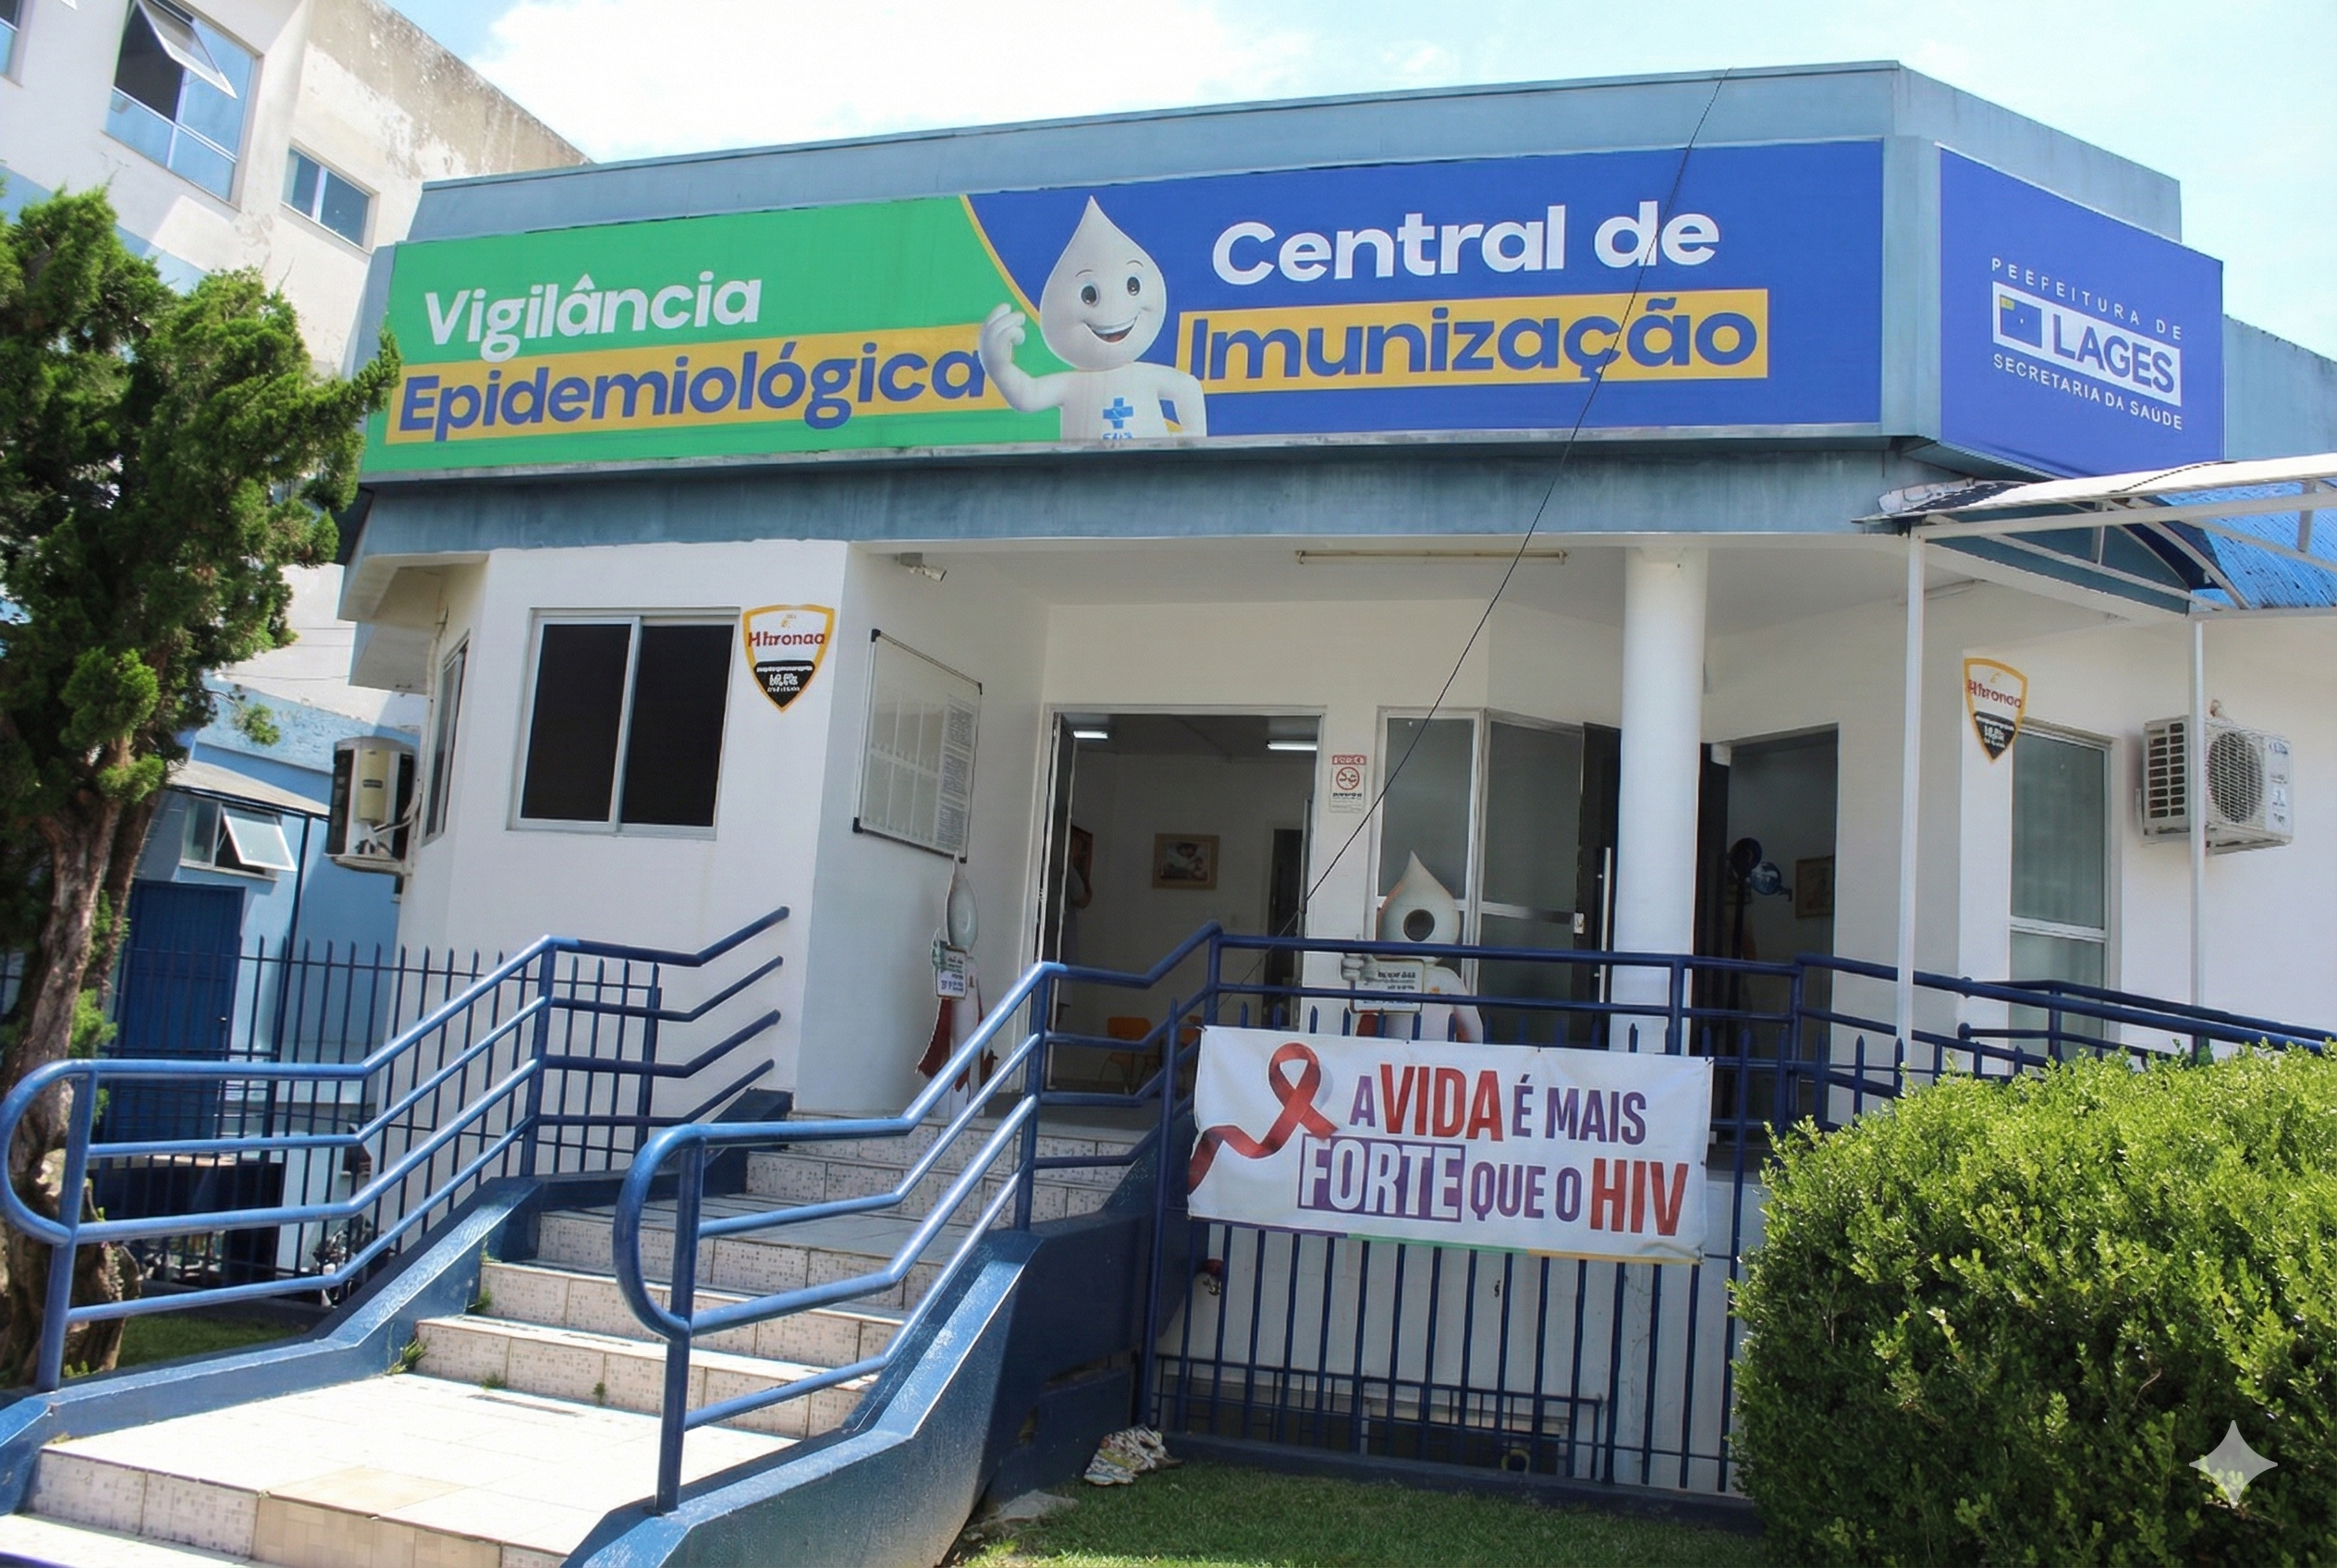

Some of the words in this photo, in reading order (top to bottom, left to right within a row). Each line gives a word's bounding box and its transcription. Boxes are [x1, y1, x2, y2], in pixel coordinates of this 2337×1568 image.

[1212, 203, 1566, 286] Central
[1594, 201, 1720, 267] de
[424, 270, 763, 362] Vigilância
[1190, 297, 1758, 383] Imunização
[2052, 313, 2175, 394] LAGES
[2156, 319, 2182, 340] DE
[398, 341, 985, 442] Epidemiológica
[1993, 353, 2101, 403] SECRETARIA
[2105, 391, 2124, 411] DA
[2130, 400, 2183, 431] SAÚDE
[1350, 1075, 1377, 1127] A
[1379, 1063, 1504, 1143] VIDA
[1511, 1073, 1533, 1137] É
[1545, 1086, 1646, 1145] MAIS
[1300, 1135, 1462, 1221] FORTE
[1470, 1161, 1547, 1221] QUE
[1556, 1166, 1582, 1222] O
[1589, 1158, 1689, 1236] HIV
